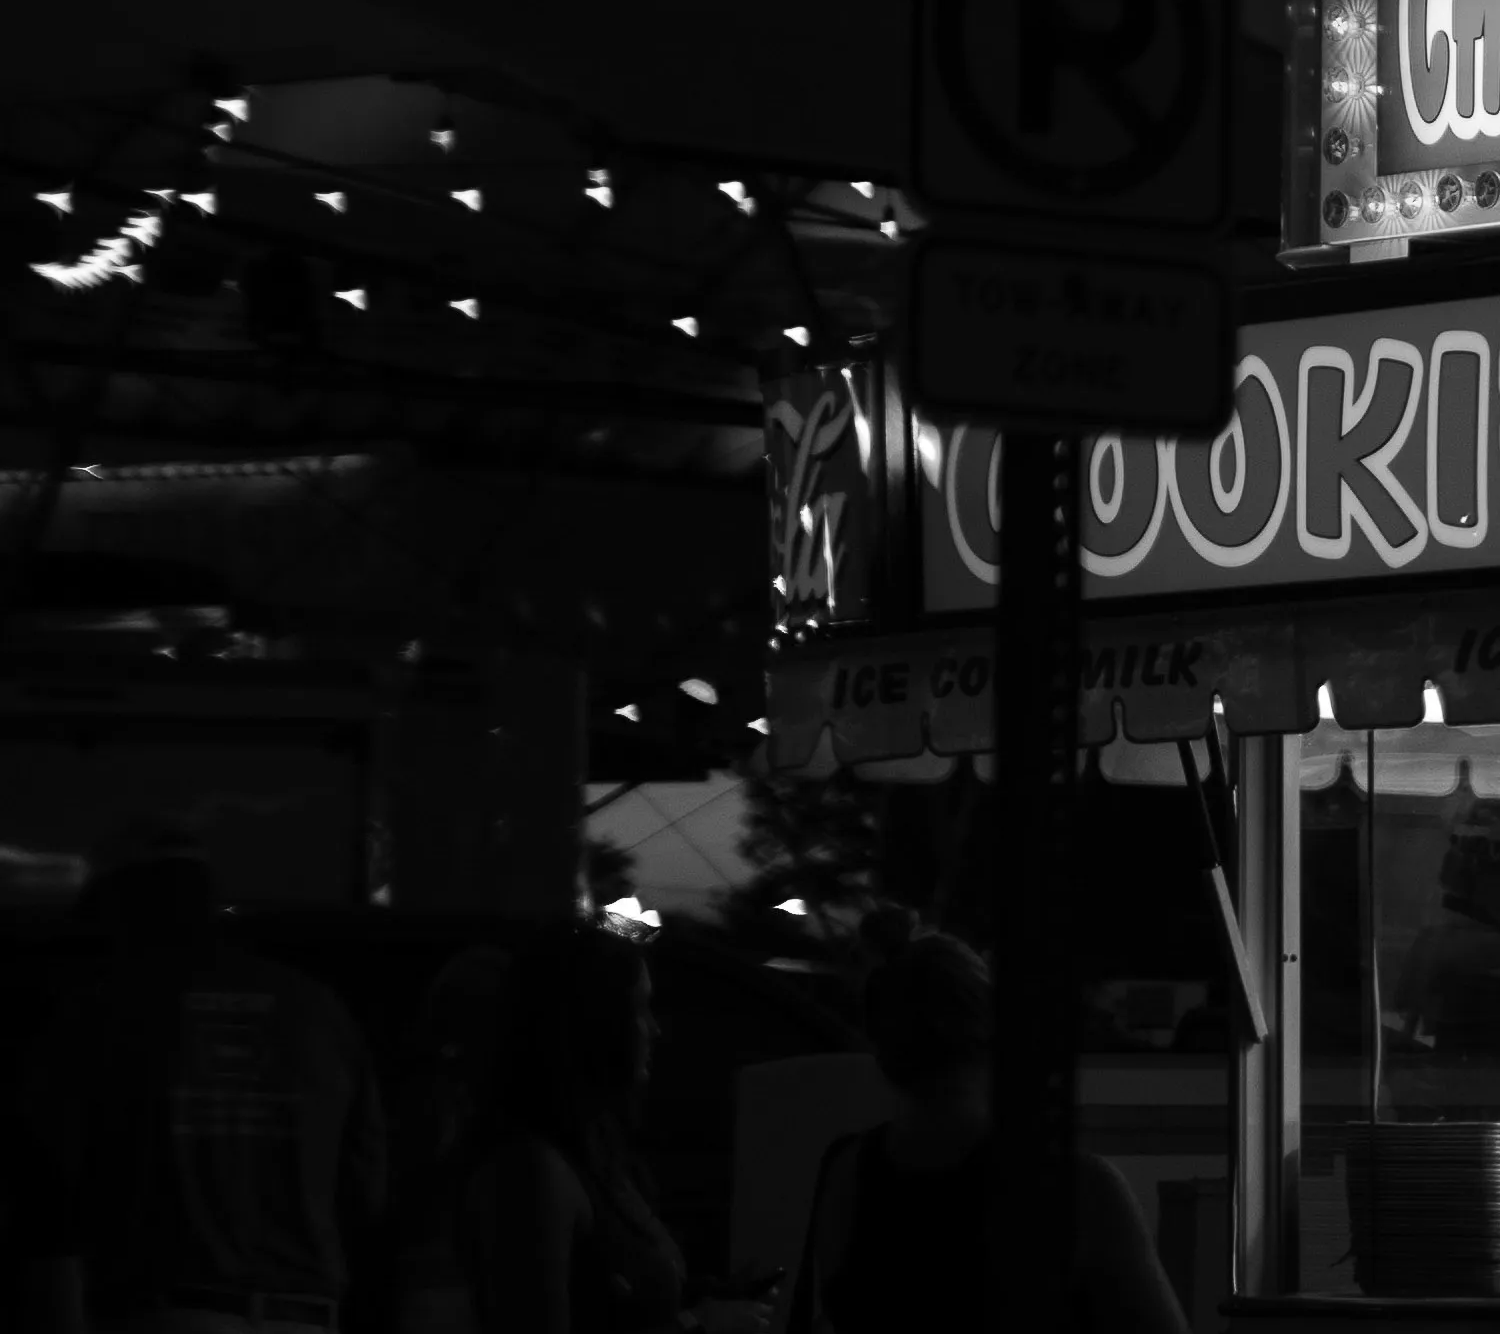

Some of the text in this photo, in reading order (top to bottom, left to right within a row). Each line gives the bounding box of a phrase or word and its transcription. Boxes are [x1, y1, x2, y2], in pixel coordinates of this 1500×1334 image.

[1013, 342, 1128, 393] ZONE
[832, 642, 1202, 709] ICE CO MILK
